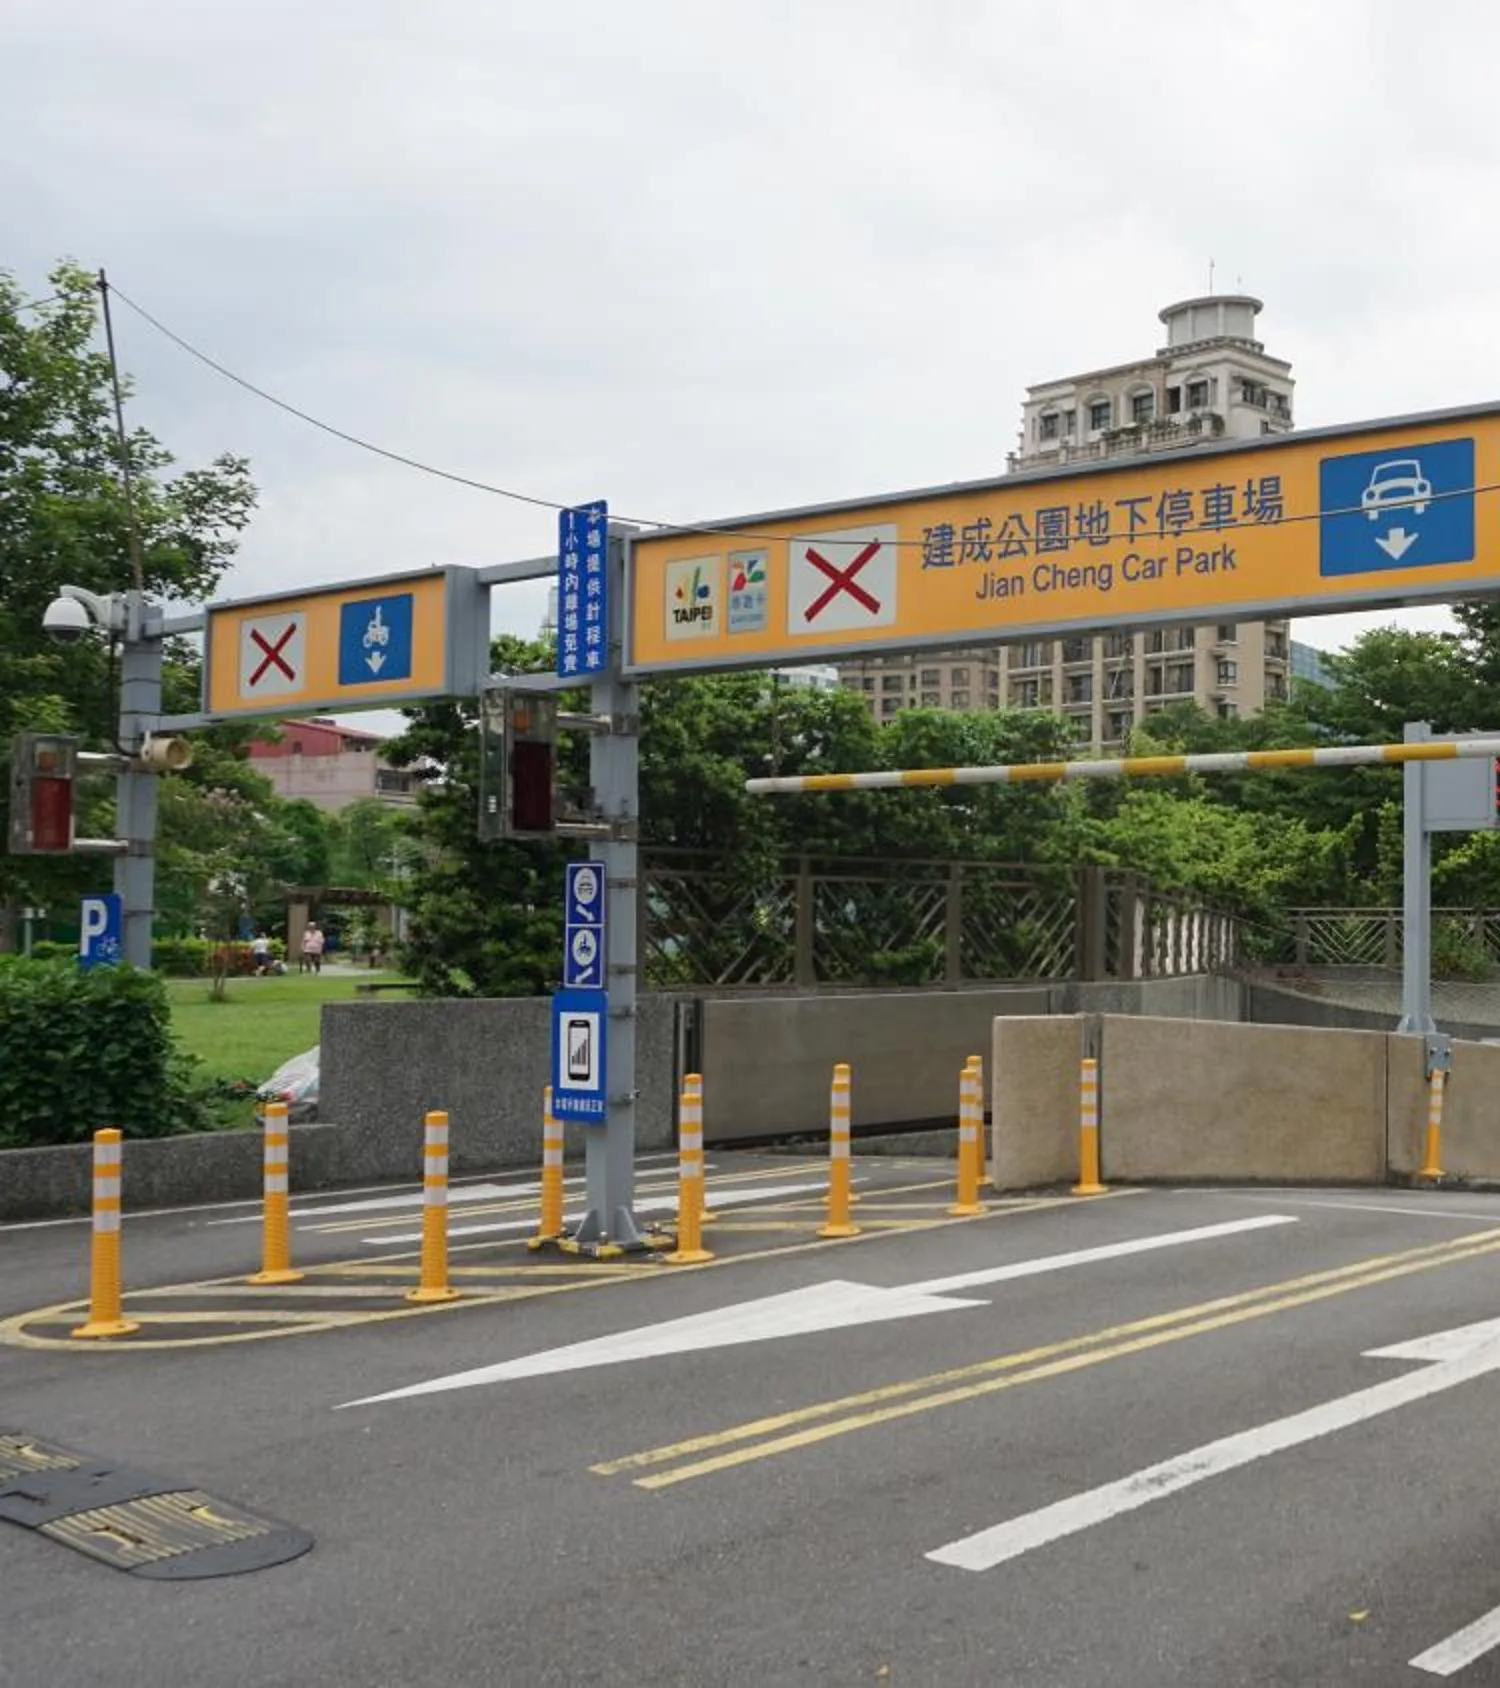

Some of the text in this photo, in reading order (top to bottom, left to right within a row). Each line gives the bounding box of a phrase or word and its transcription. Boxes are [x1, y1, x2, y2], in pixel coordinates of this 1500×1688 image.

[922, 475, 1284, 569] 建成公園地下停車場
[976, 543, 1236, 600] Jian Cheng Car Park
[81, 899, 108, 956] P
